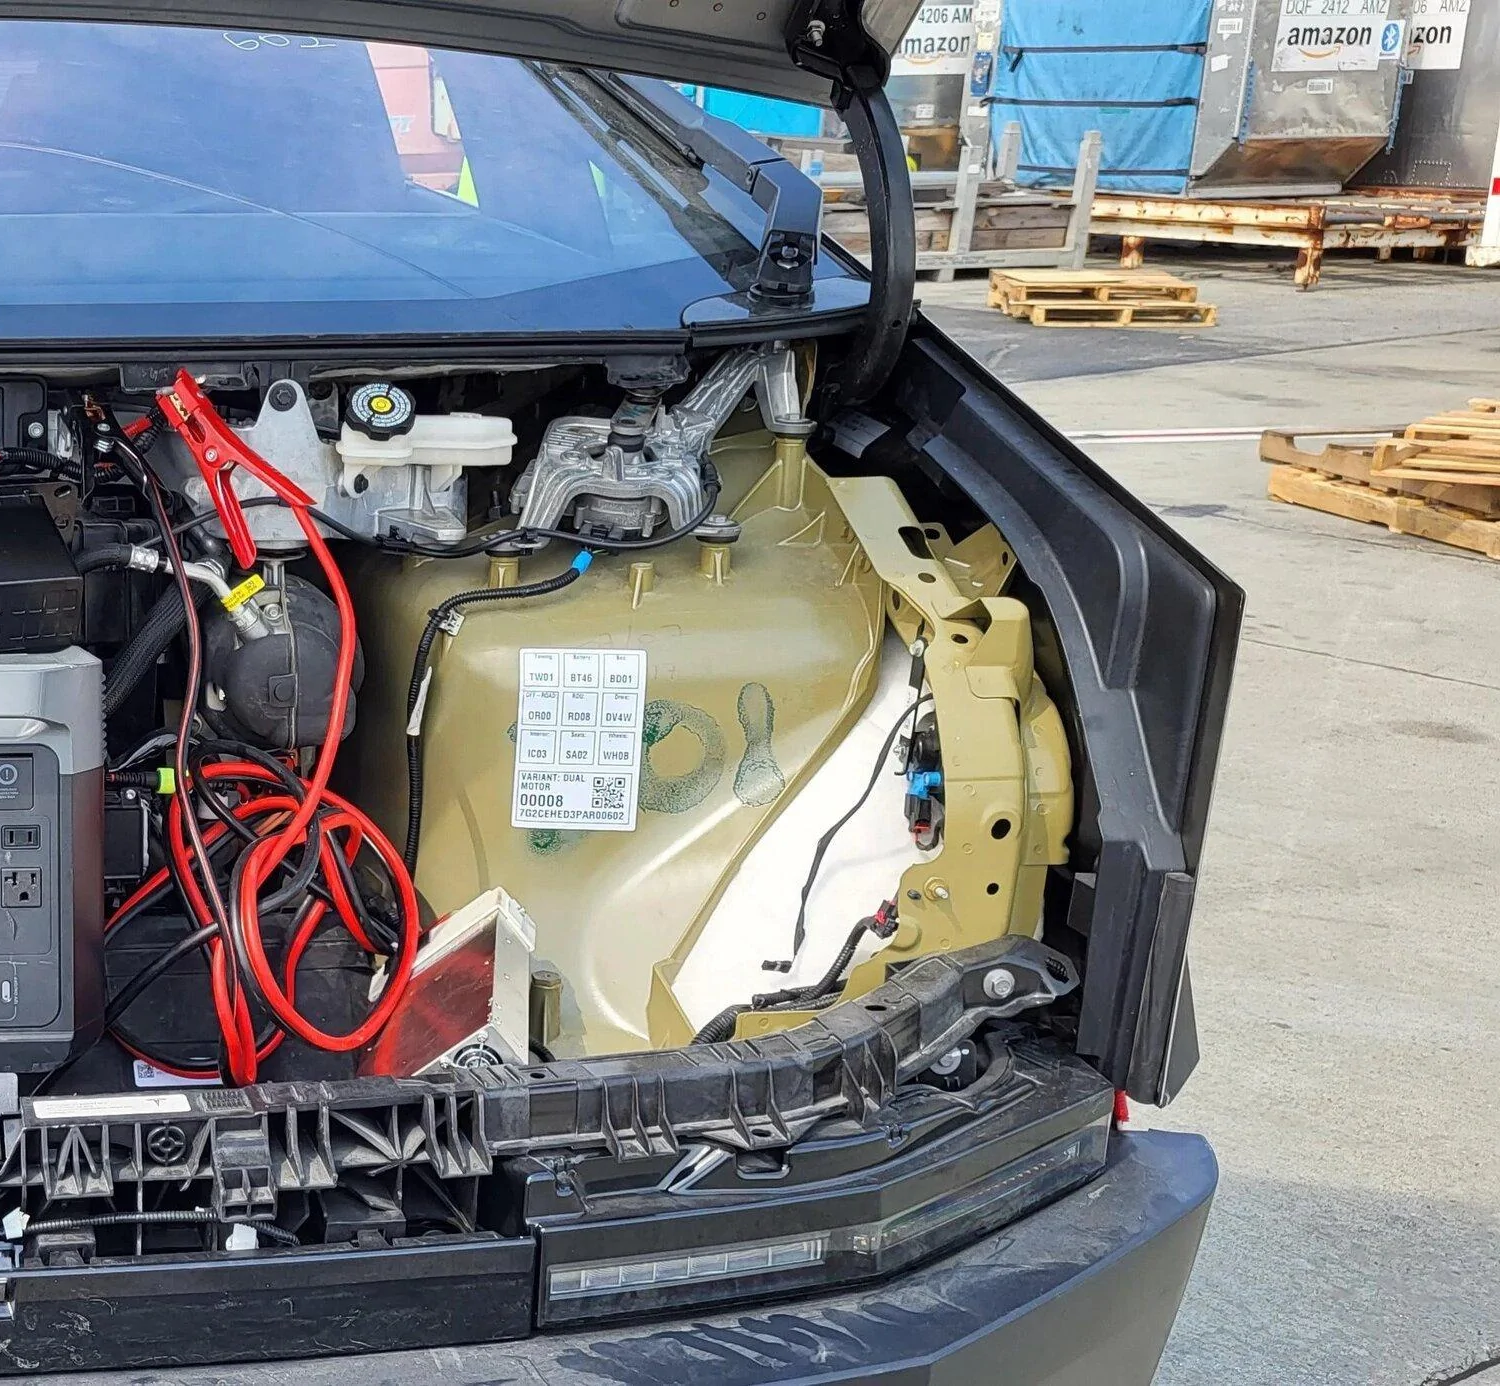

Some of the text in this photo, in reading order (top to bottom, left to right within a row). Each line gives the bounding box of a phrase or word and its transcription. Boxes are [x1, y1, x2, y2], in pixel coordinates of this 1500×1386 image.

[918, 8, 948, 23] 4206
[1287, 26, 1372, 46] amazon
[1409, 26, 1452, 44] zon
[898, 35, 970, 54] mazon
[530, 673, 553, 682] TW01
[571, 673, 592, 682] BT46
[528, 749, 547, 758] IC03
[566, 750, 588, 759] SA02
[521, 772, 586, 782] VARIANT: DUAL
[520, 782, 550, 791] MOTOR
[520, 794, 563, 807] 00008
